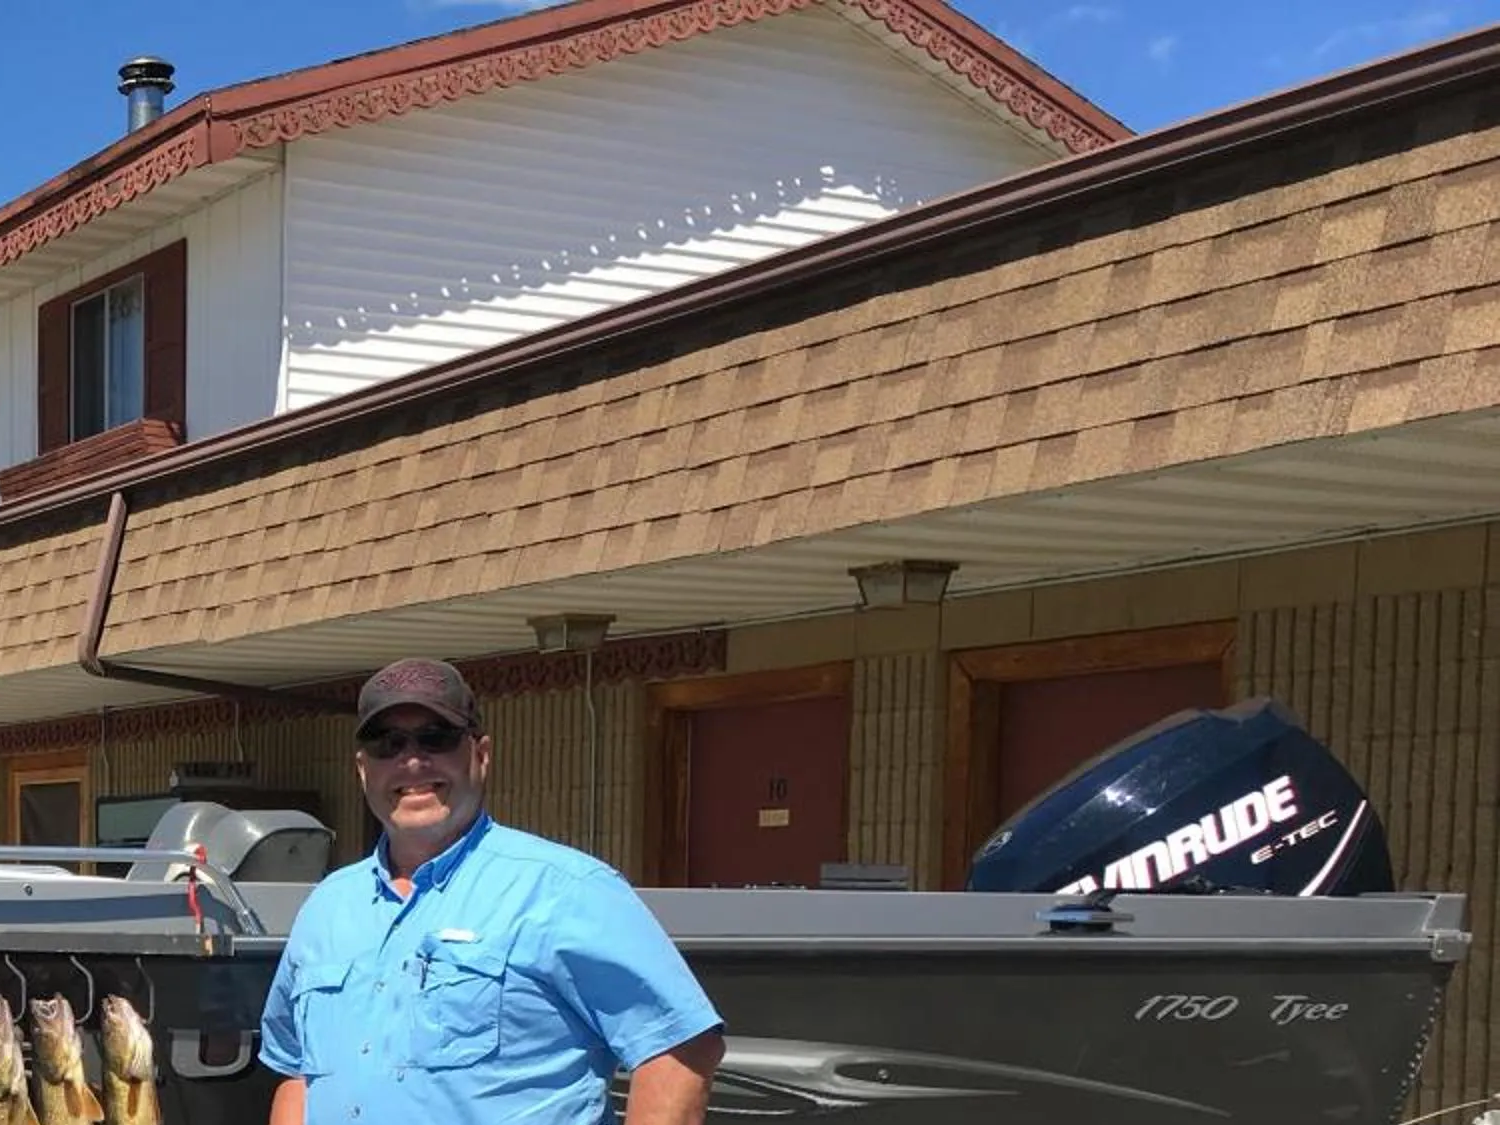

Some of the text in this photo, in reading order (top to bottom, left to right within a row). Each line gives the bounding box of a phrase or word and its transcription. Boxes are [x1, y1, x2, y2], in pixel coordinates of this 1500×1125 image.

[1251, 809, 1339, 864] E-TEC
[1134, 994, 1350, 1026] 1750 Tyee
